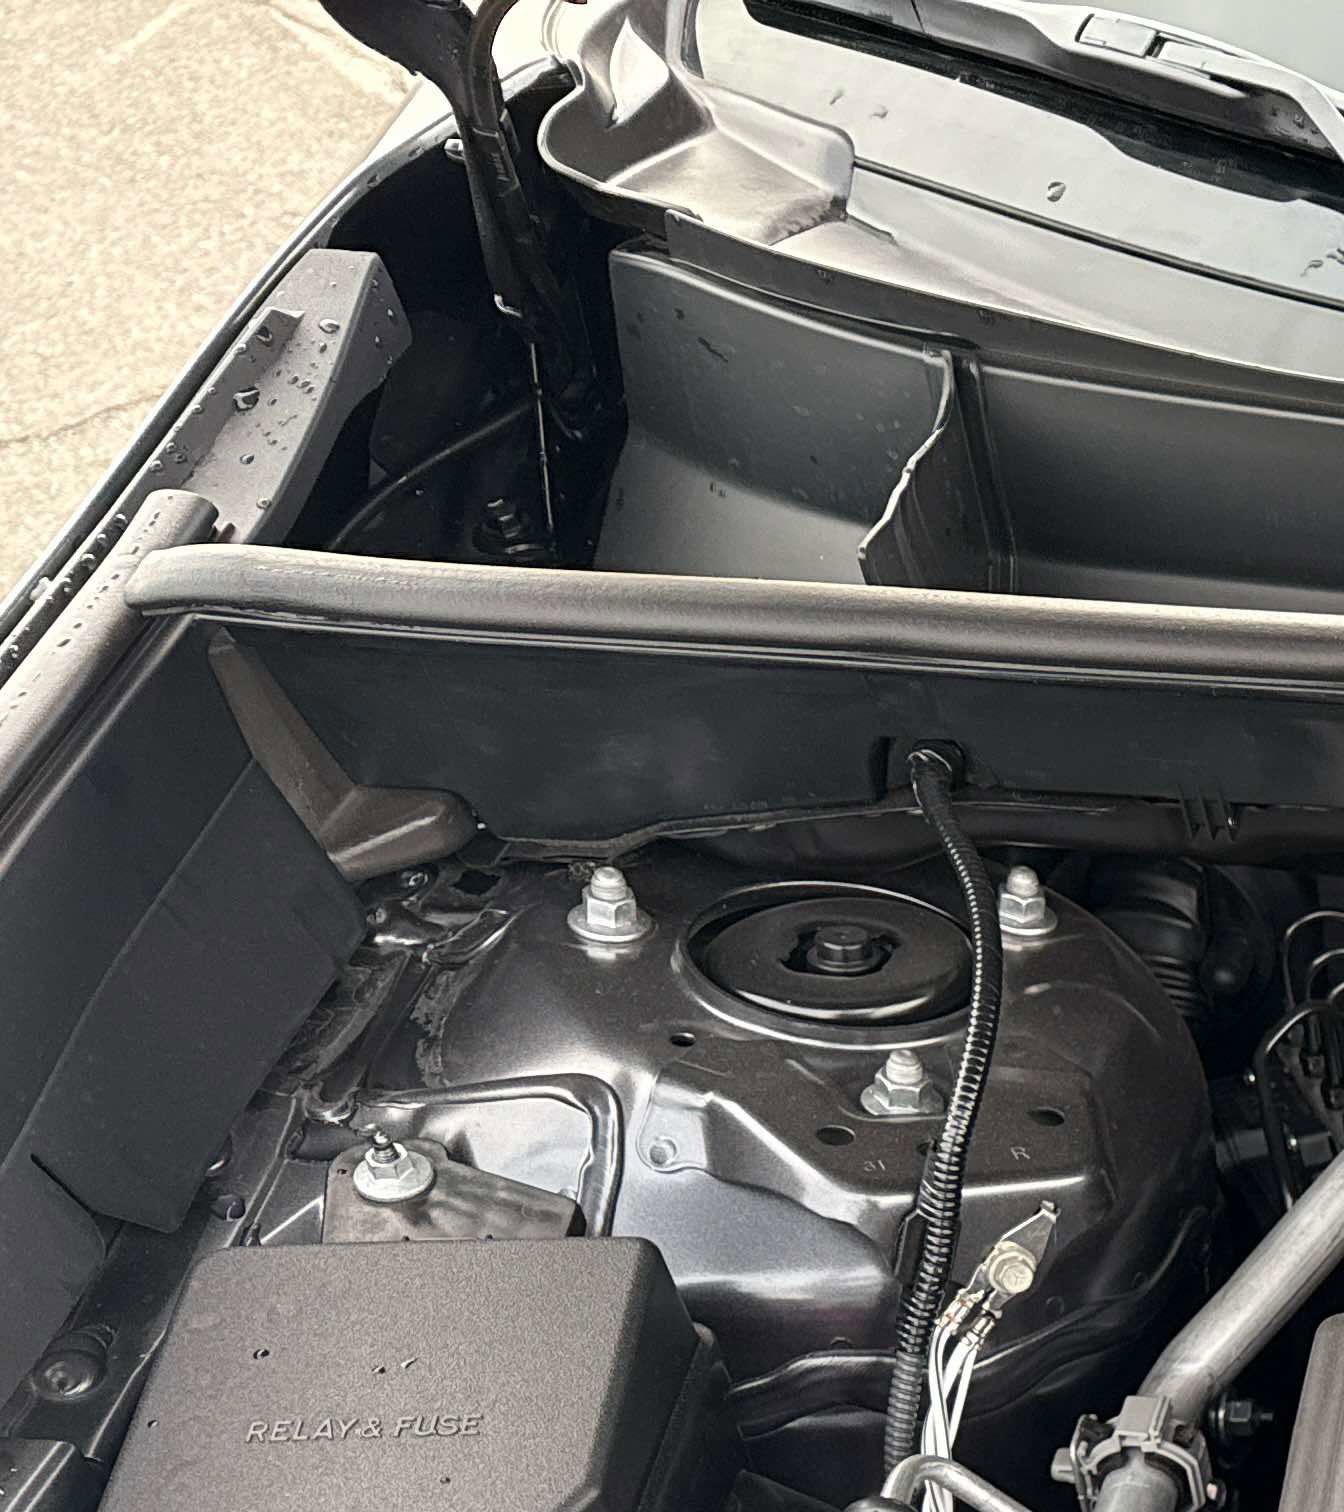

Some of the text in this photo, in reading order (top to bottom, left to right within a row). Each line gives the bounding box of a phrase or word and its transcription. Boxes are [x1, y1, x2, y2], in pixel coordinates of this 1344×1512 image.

[247, 1415, 484, 1443] RELAY & FUSE
